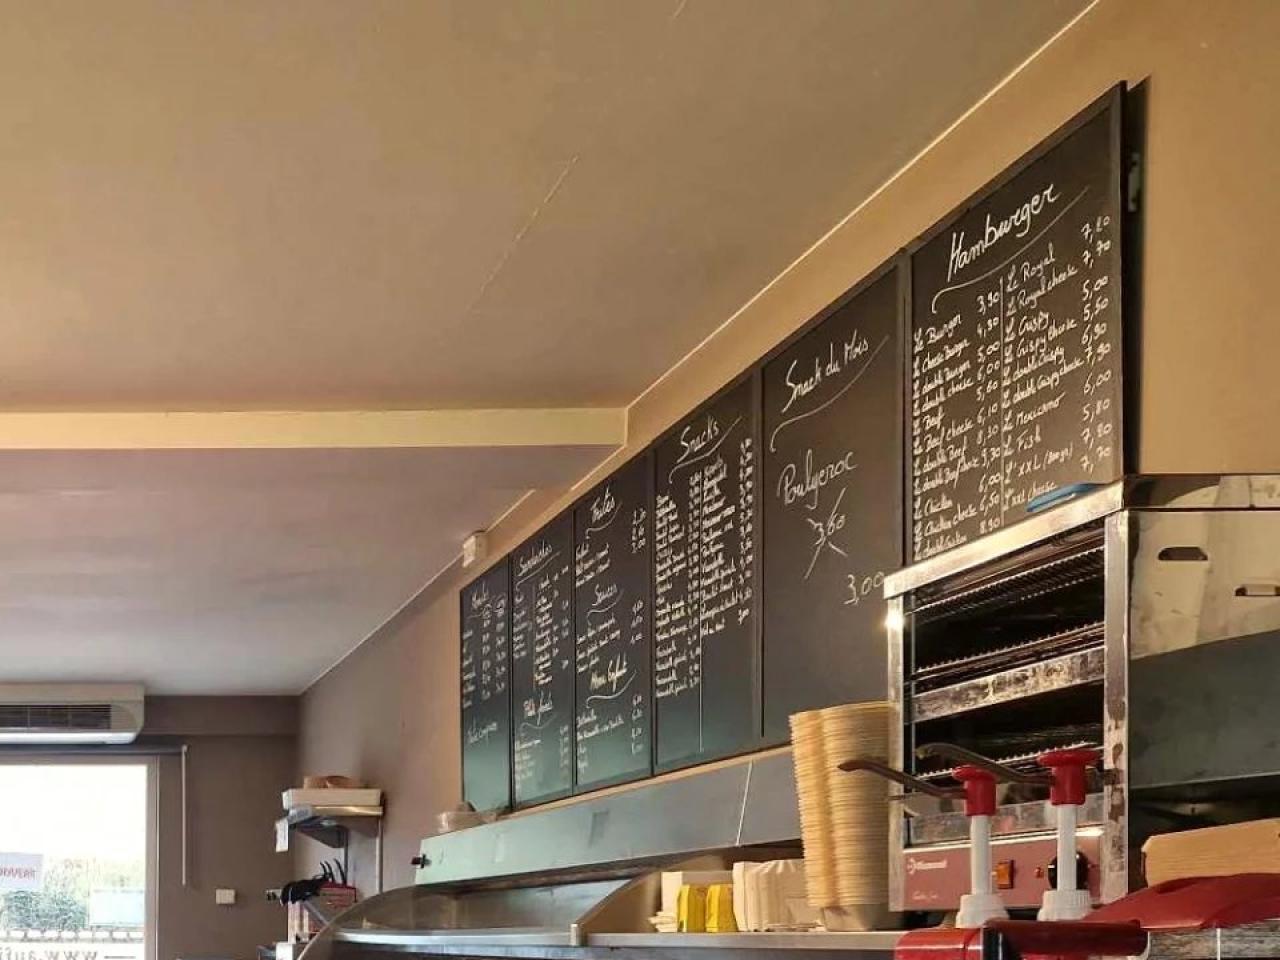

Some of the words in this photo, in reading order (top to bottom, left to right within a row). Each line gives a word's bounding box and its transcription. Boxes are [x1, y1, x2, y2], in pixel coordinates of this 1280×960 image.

[947, 183, 1062, 283] Hamburger
[1021, 242, 1056, 282] Royal
[1082, 275, 1109, 301] 5,00
[825, 342, 841, 377] du
[1084, 369, 1112, 397] 6,00
[677, 415, 719, 463] Snacks
